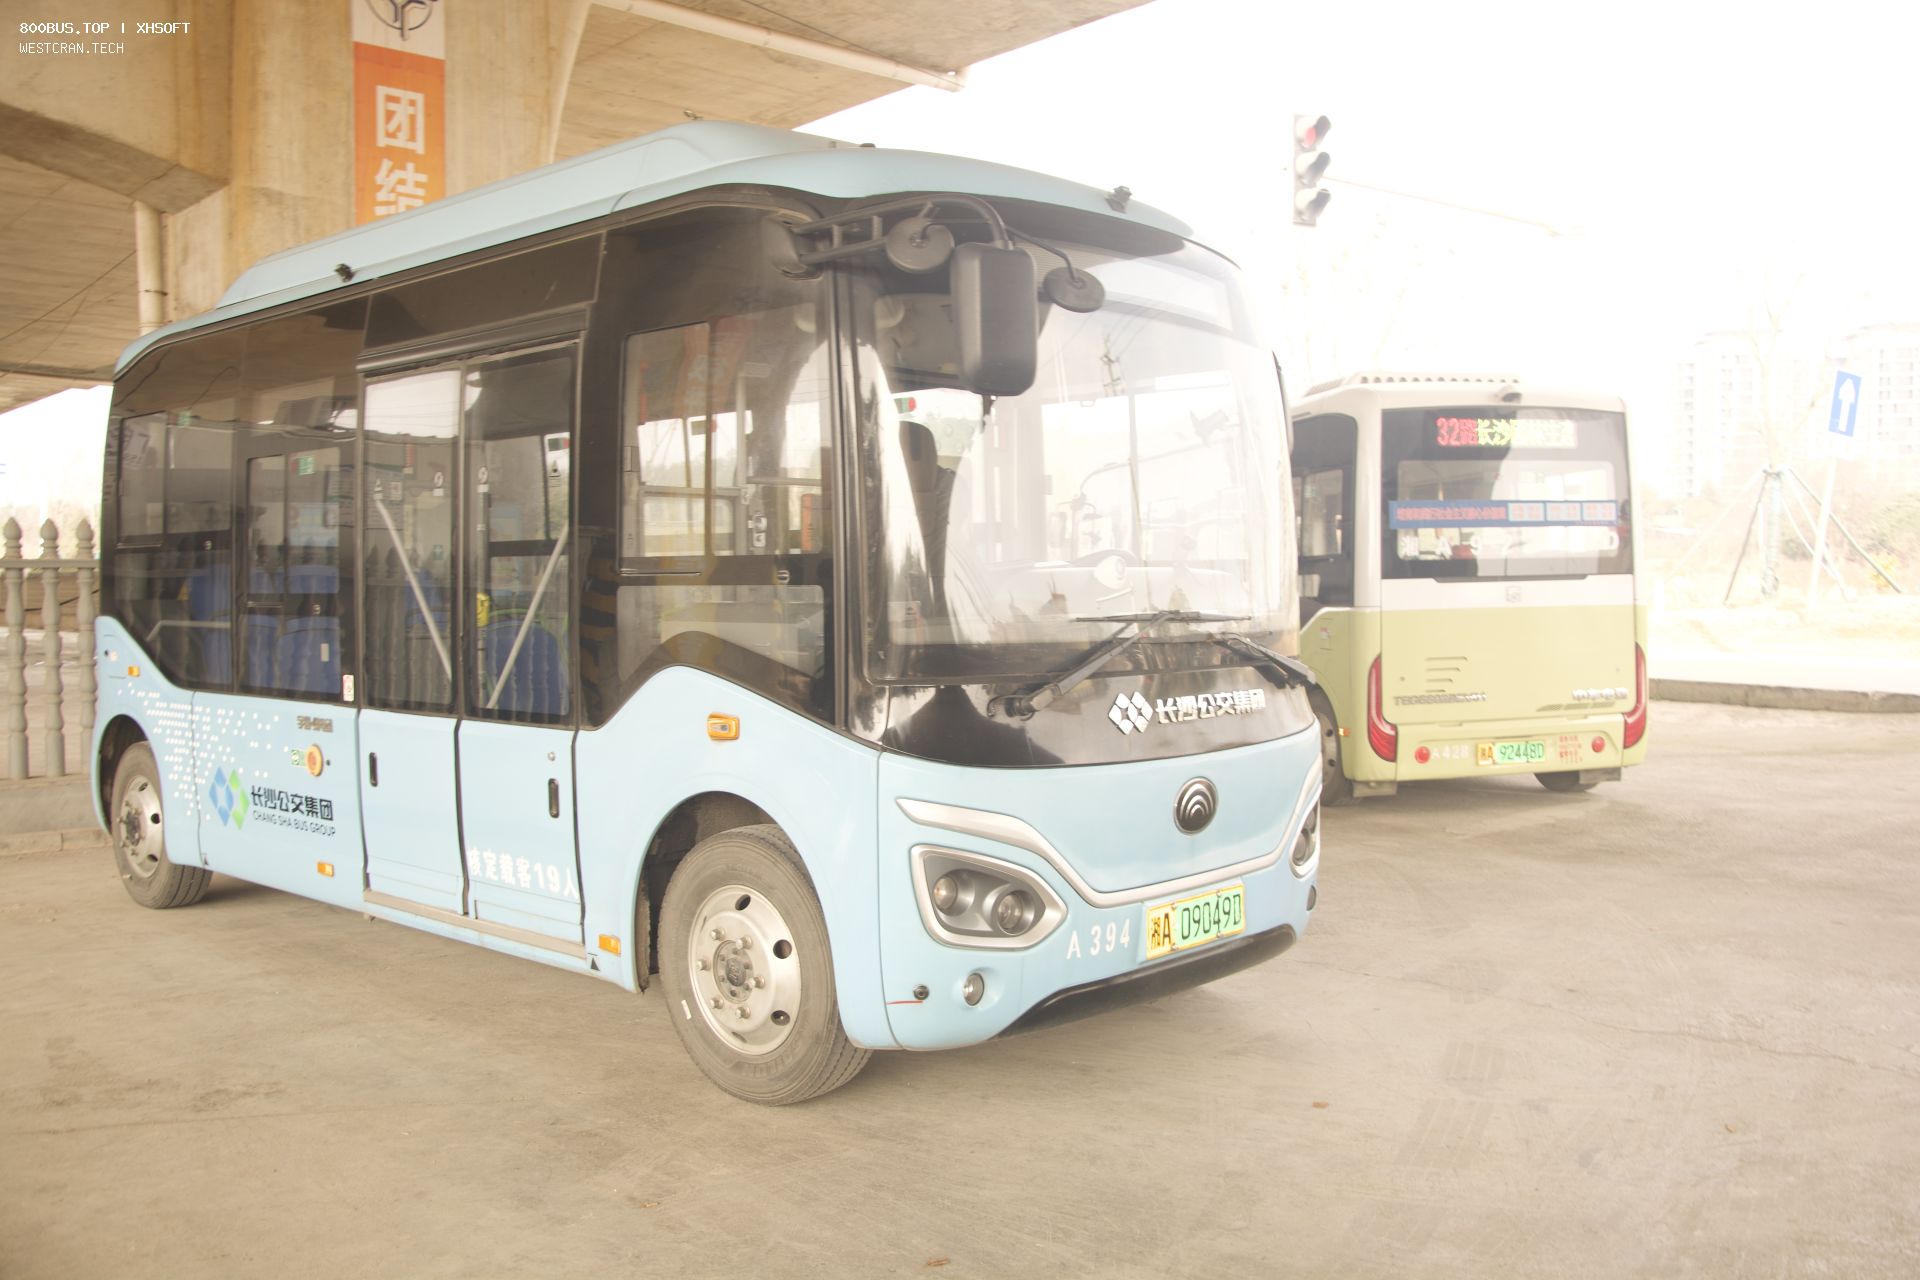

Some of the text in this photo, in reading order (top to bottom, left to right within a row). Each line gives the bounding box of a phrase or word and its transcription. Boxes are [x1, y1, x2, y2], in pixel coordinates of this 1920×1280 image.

[1155, 688, 1267, 724] 长沙公交集团
[250, 785, 334, 822] 长沙公交集团
[294, 818, 309, 832] BUS
[310, 822, 336, 838] GROUP
[1090, 918, 1131, 956] 394
